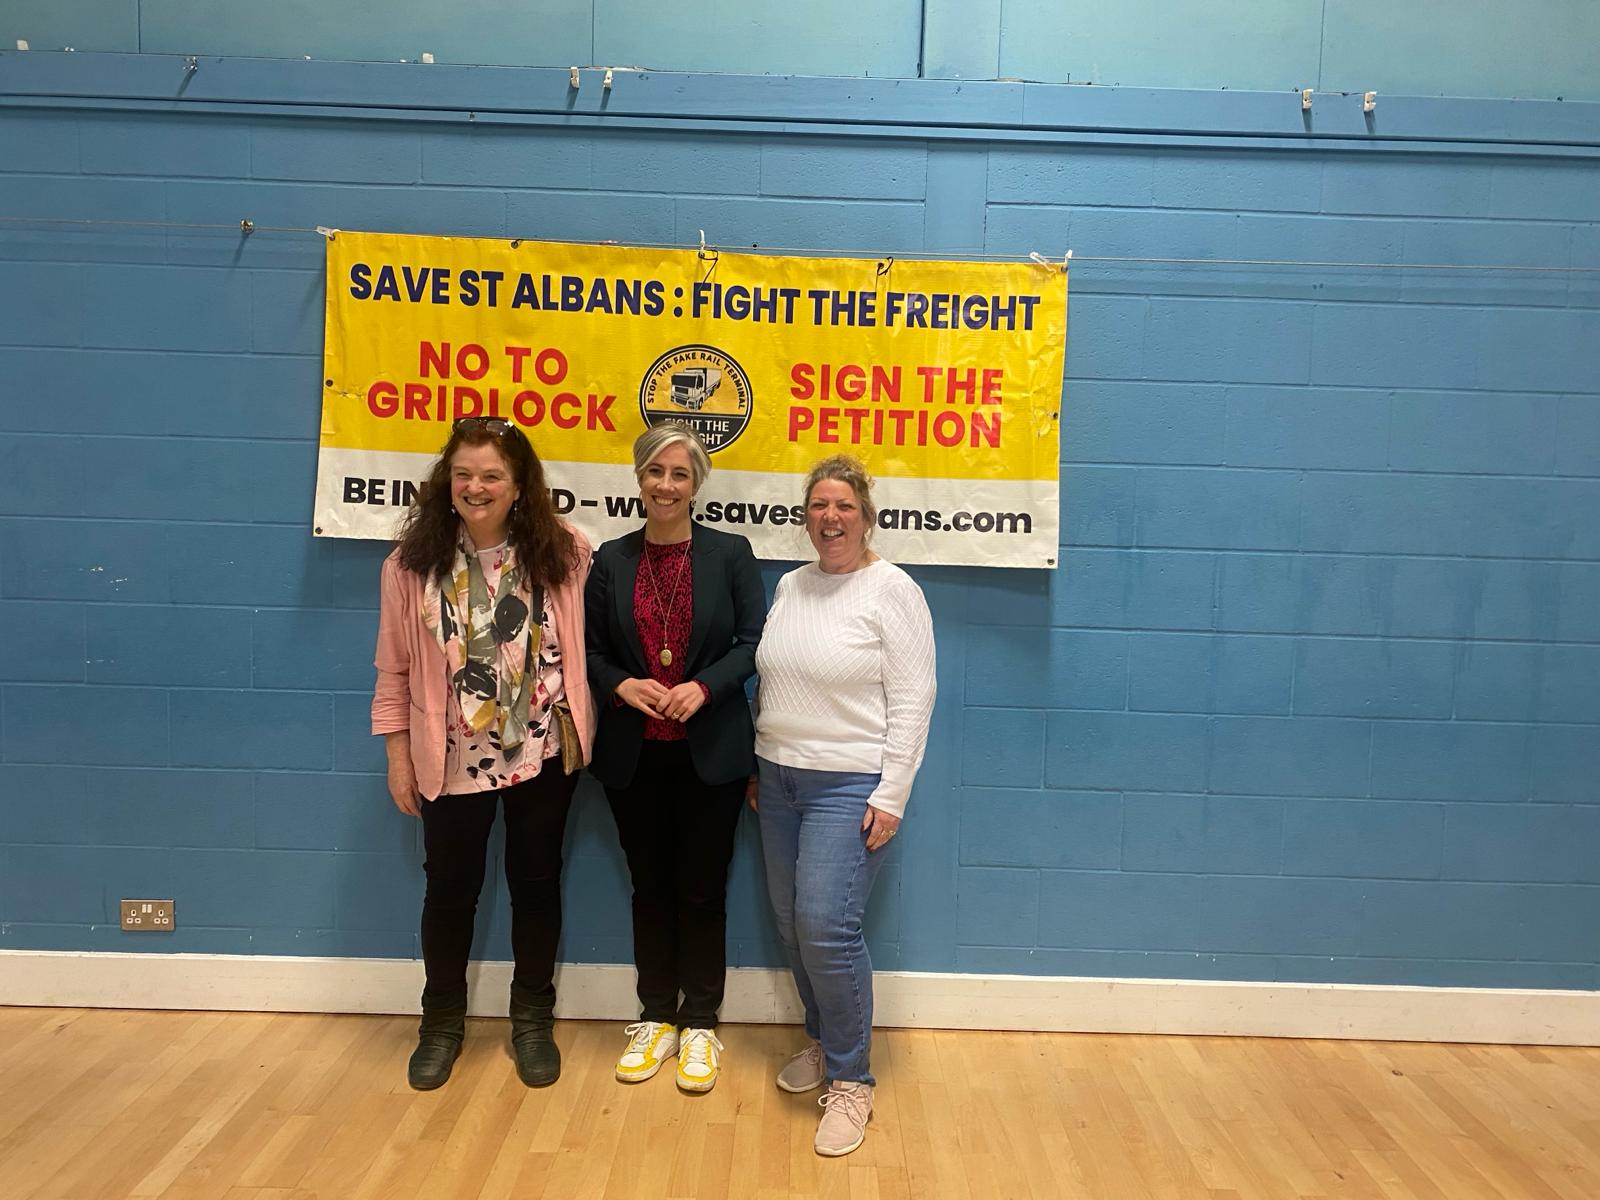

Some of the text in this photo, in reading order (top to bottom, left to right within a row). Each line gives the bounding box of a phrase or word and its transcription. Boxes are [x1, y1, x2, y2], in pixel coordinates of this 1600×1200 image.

[350, 263, 450, 305] SAVE
[459, 269, 504, 307] ST
[511, 273, 665, 317] ALBANS
[692, 281, 801, 324] FIGHT
[808, 289, 877, 327] THE
[885, 293, 1041, 331] FREIGHT
[419, 340, 568, 386] NO TO
[647, 352, 746, 410] STOP THE FAKE RAIL TERMINAL
[790, 363, 1004, 406] SIGN THE
[367, 380, 617, 432] GRIDLOCK
[705, 420, 730, 432] THE
[788, 406, 1001, 448] PETITION
[343, 477, 386, 506] BE
